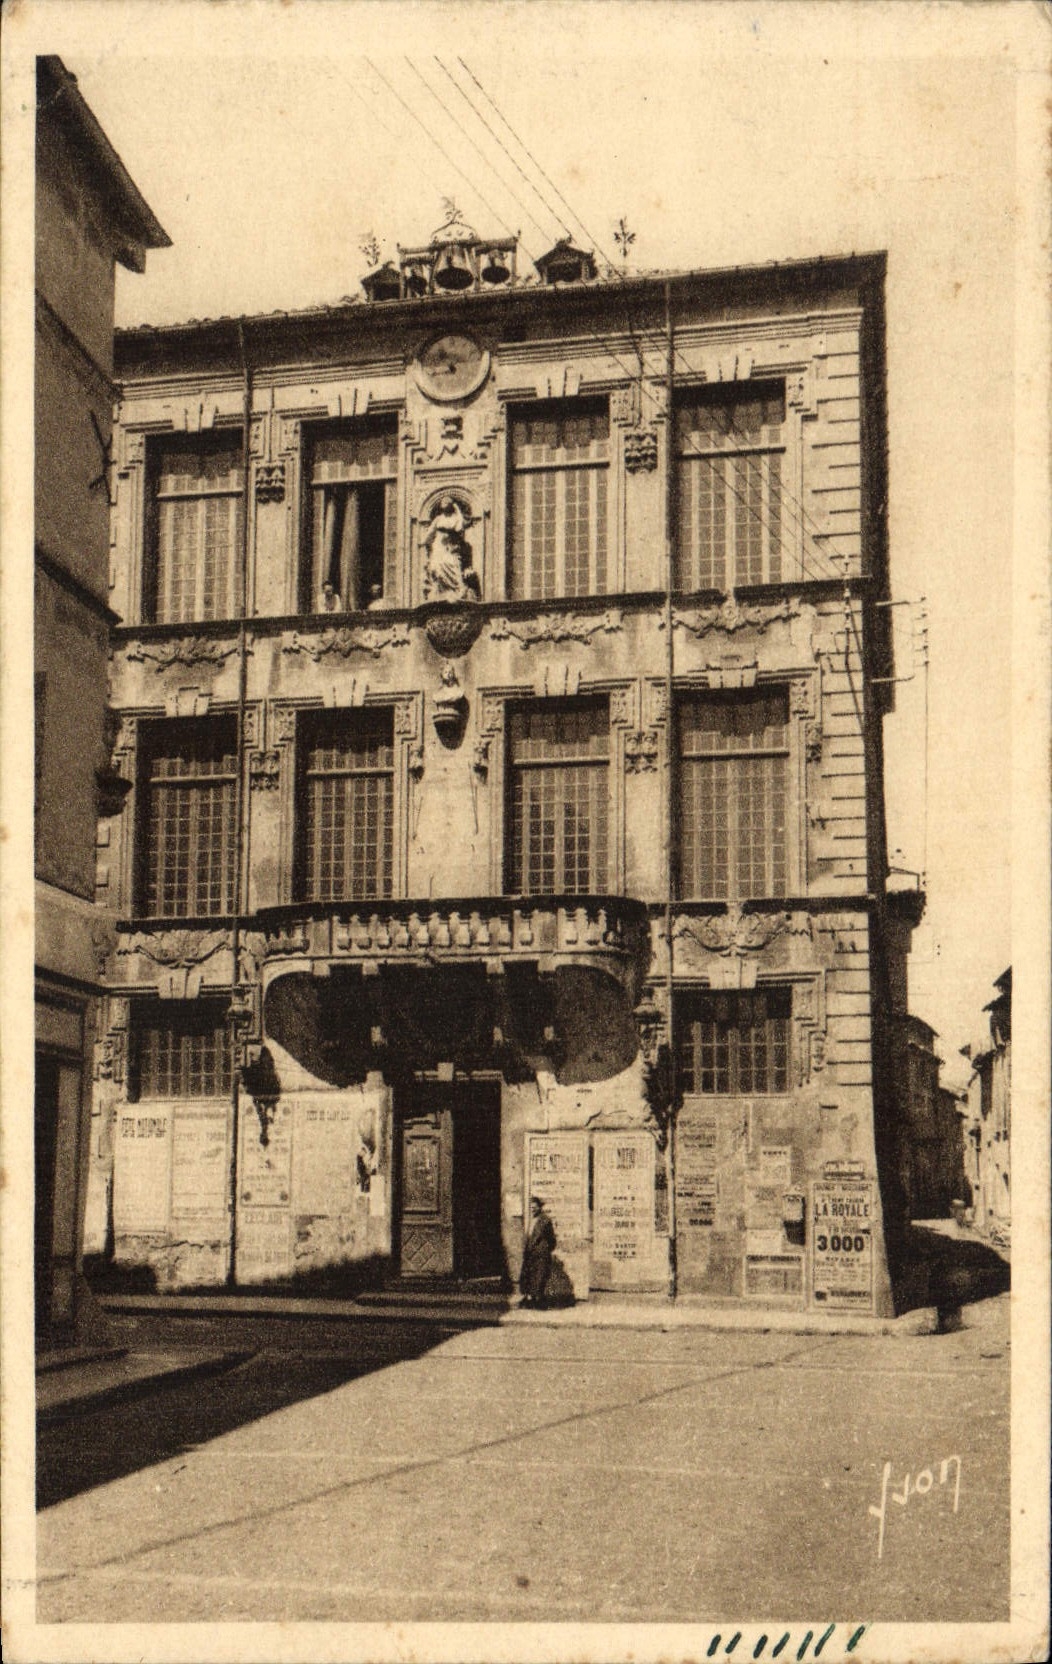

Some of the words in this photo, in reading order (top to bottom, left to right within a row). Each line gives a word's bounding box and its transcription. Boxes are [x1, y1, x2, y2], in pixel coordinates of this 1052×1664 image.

[815, 1202, 829, 1217] LA
[832, 1202, 870, 1217] ROYALE
[817, 1235, 865, 1252] 3000
